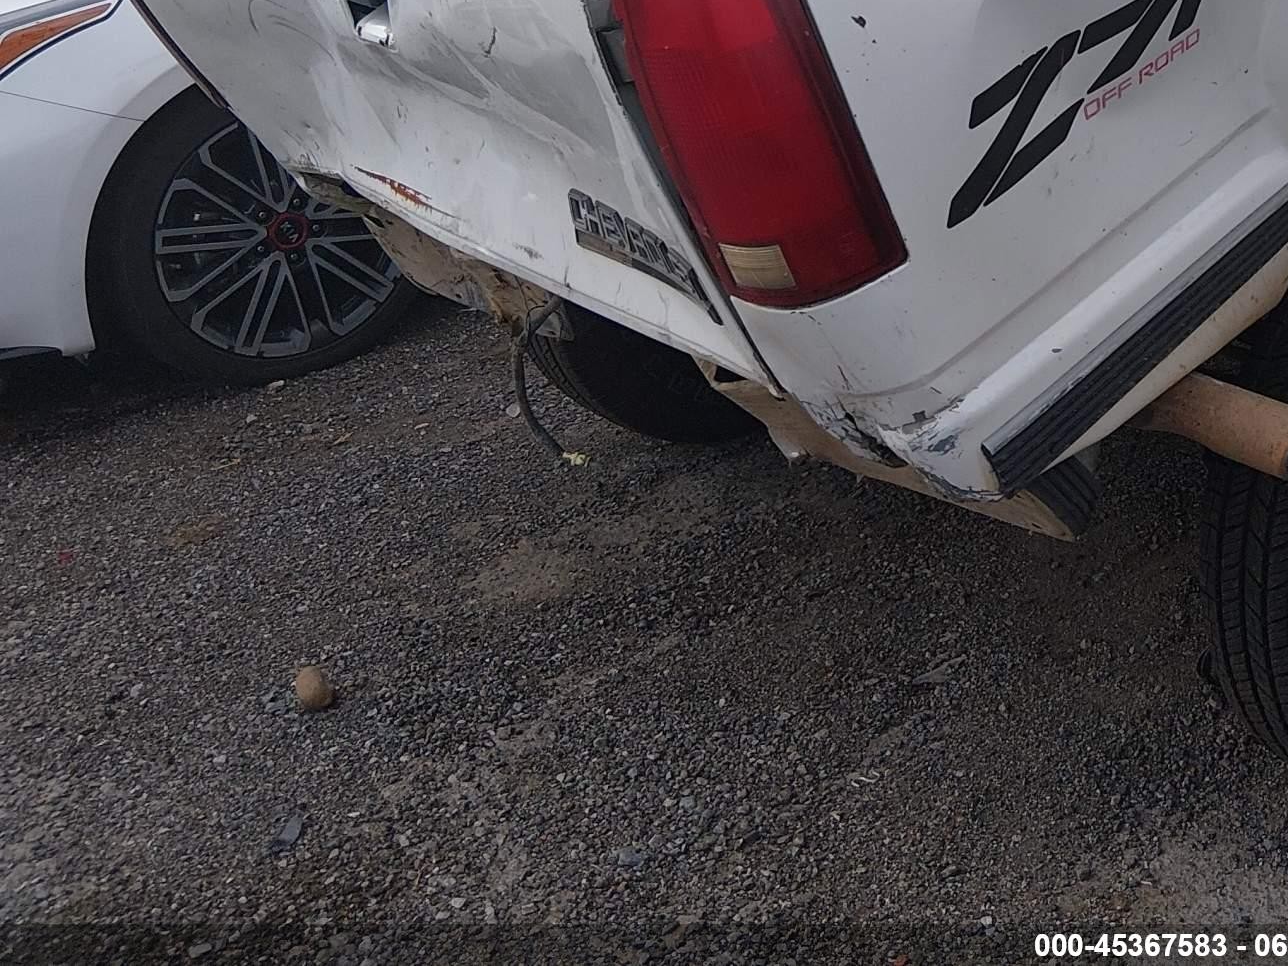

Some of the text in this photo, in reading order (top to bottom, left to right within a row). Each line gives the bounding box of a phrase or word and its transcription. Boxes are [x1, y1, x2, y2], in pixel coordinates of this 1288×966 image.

[1083, 27, 1202, 121] OFF ROAD
[567, 186, 709, 312] CHEVROLE
